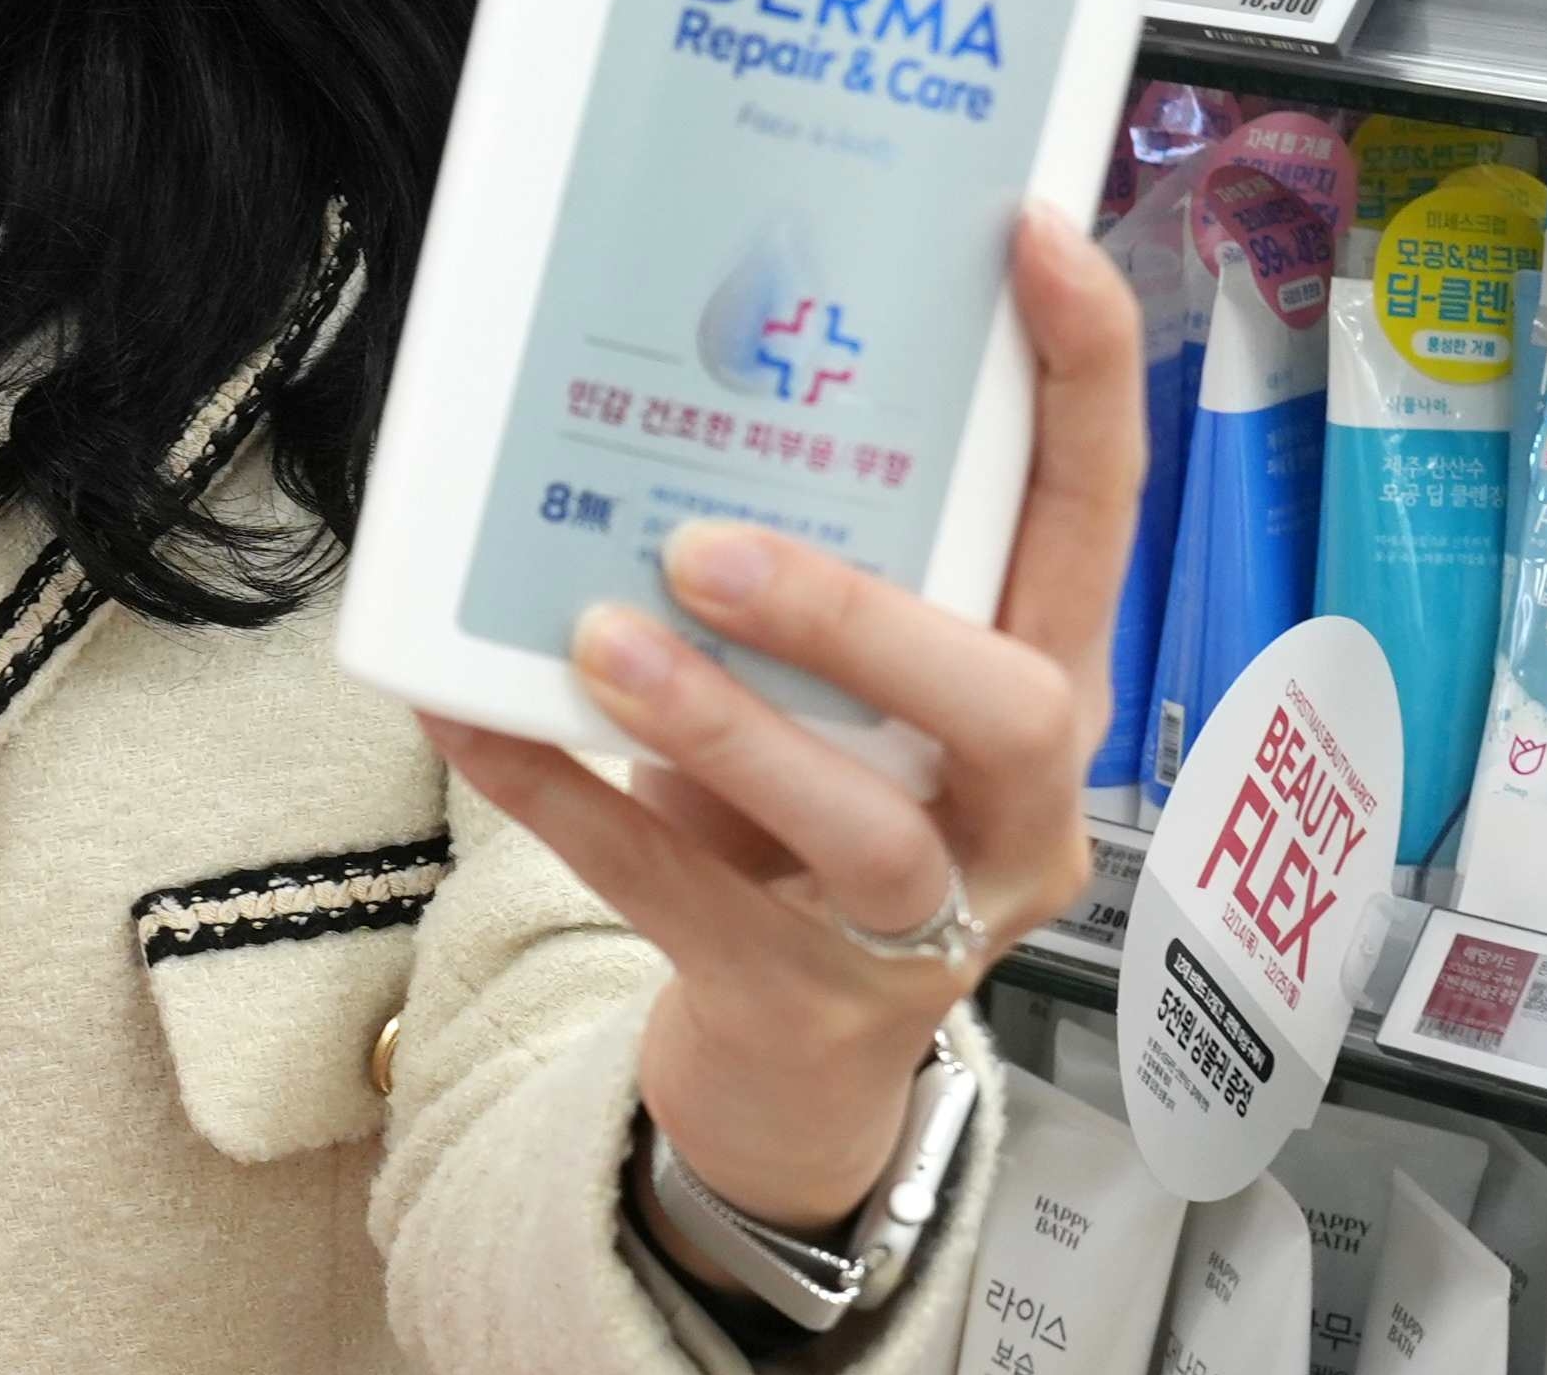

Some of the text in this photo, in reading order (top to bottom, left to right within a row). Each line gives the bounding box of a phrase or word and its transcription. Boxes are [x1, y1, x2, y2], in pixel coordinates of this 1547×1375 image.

[674, 5, 995, 122] Repair & Care
[567, 377, 737, 453] 민감 건조한
[538, 479, 615, 535] 8無
[1255, 703, 1368, 876] BEAUTY
[1195, 773, 1338, 984] FLEX
[1034, 1194, 1093, 1237] HAPPY
[1036, 1216, 1082, 1251] BATH
[984, 1279, 1069, 1351] 라이스
